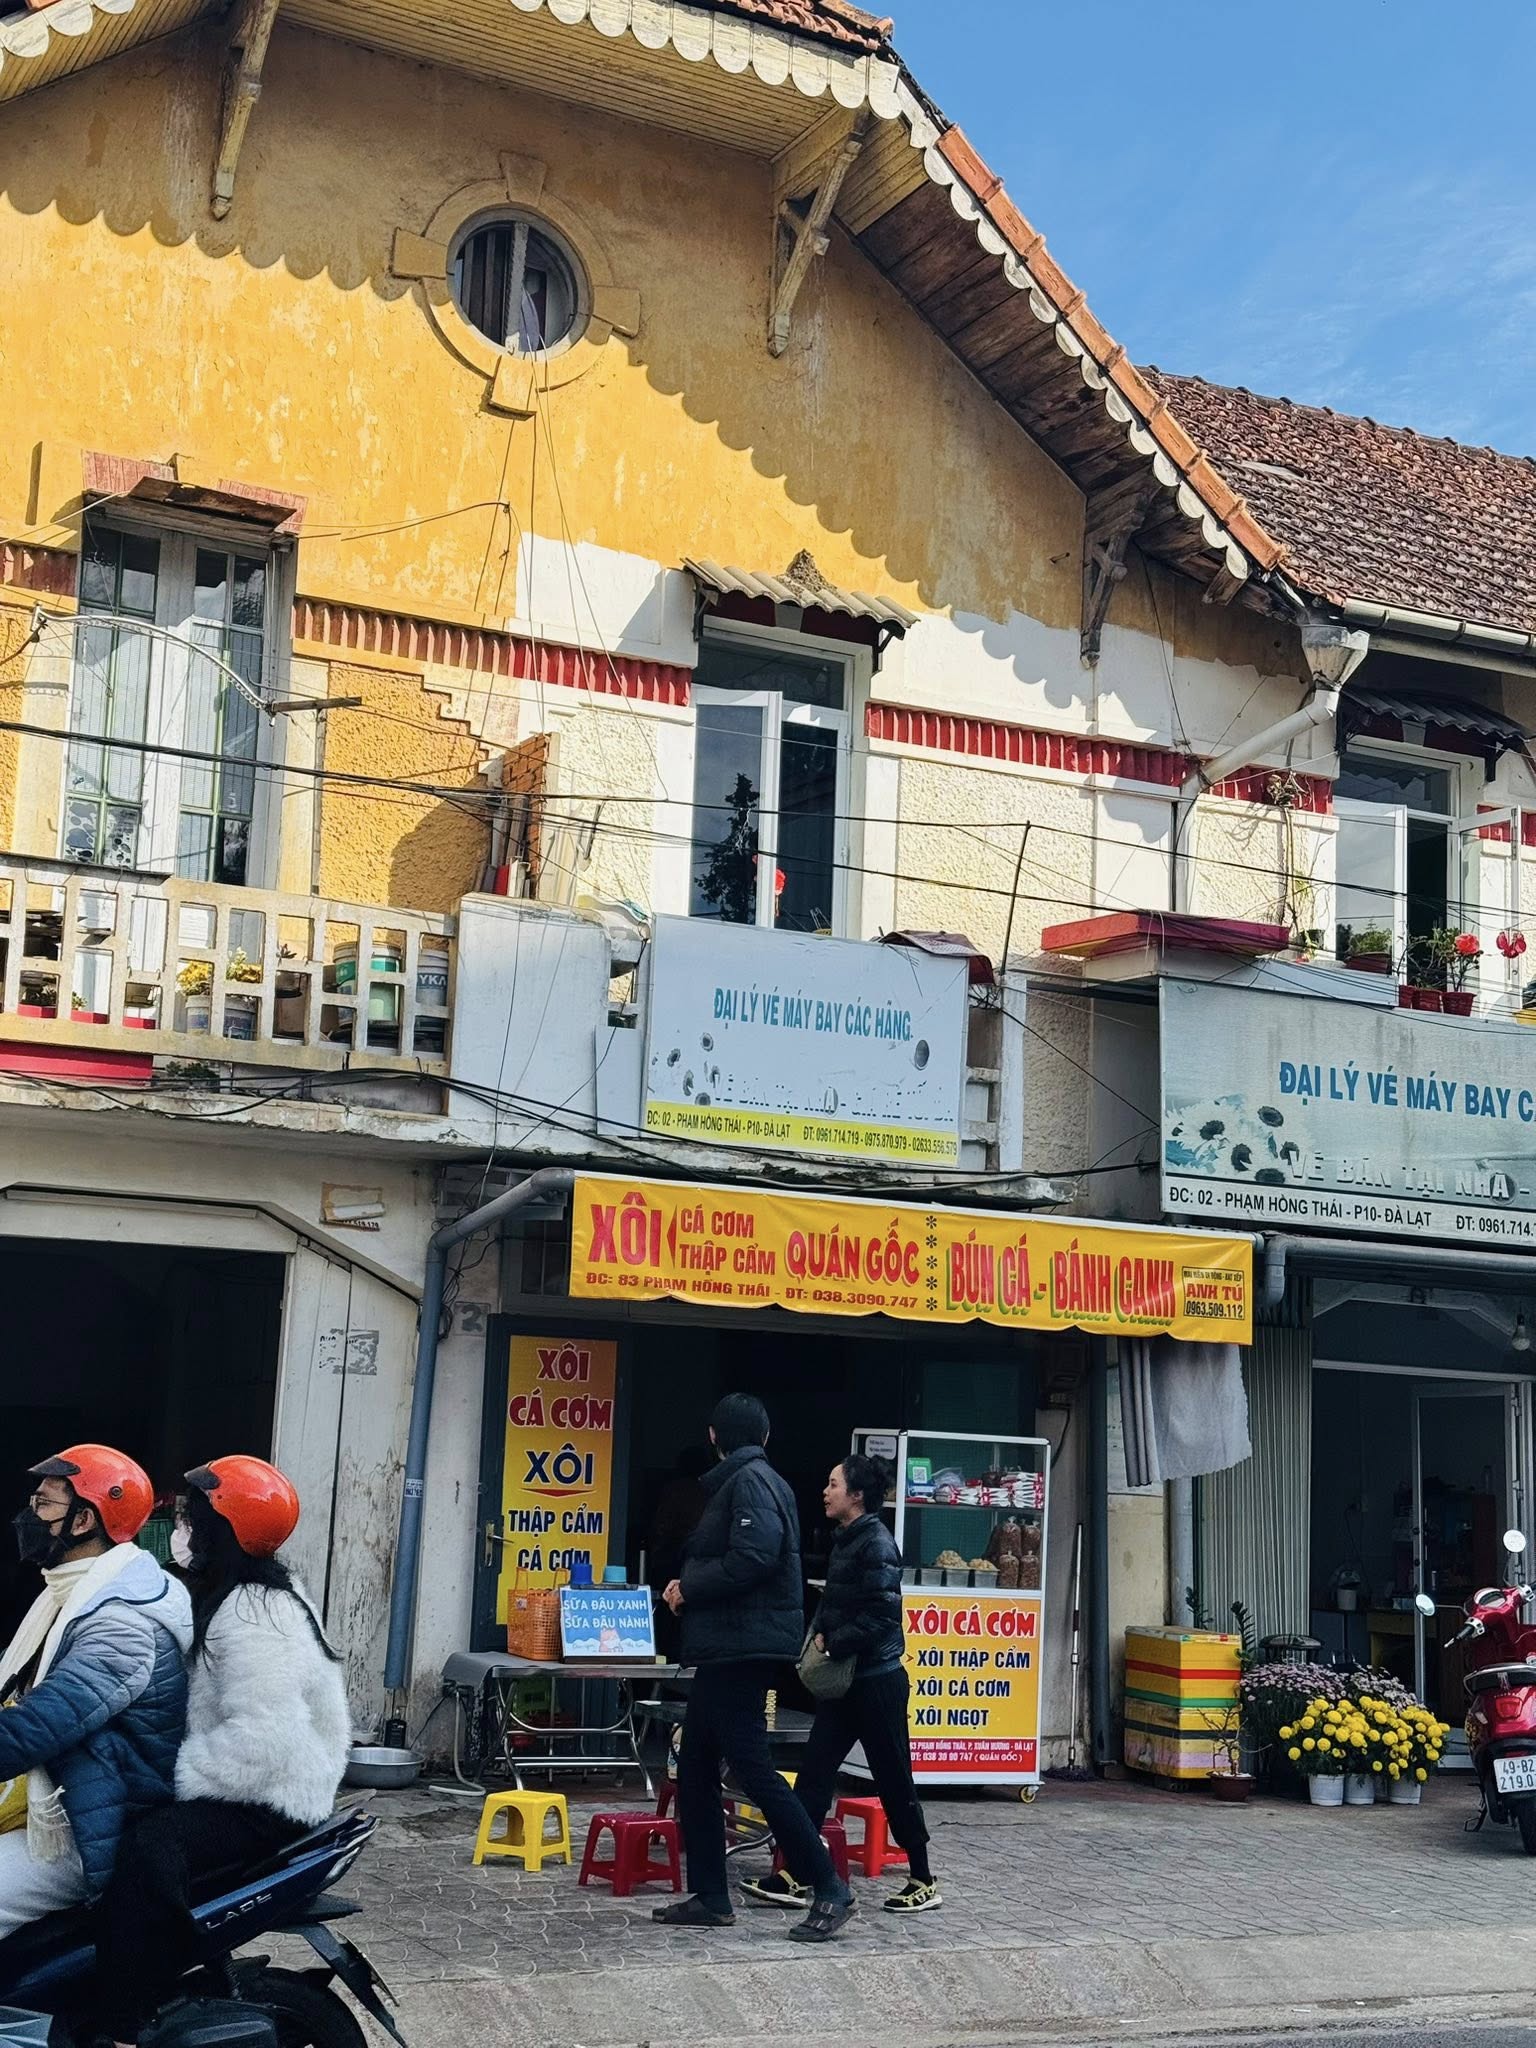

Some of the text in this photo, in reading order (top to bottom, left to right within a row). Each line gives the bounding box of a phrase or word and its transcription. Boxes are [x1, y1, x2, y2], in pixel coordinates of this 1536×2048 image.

[713, 987, 738, 1030] ĐẠI
[740, 983, 759, 1023] LÝ
[762, 986, 780, 1026] VÉ
[783, 989, 813, 1030] MÁY
[815, 1000, 843, 1033] BAY
[844, 996, 872, 1037] CÁC
[1279, 1060, 1536, 1122] ĐẠI LÝ VÉ MÁY BAY C
[647, 1110, 660, 1126] ĐC:
[662, 1111, 671, 1127] 02
[676, 1112, 699, 1132] PHẠM
[724, 1115, 742, 1134] THÁI
[776, 1124, 791, 1141] LẠT
[803, 1126, 815, 1141] ĐT:
[816, 1127, 859, 1145] 0961.714.719
[680, 1203, 754, 1239] CÁ CƠM
[1169, 1186, 1194, 1204] ĐC:
[1197, 1189, 1213, 1206] 02
[1225, 1192, 1264, 1213] PHẠM
[1311, 1198, 1342, 1218] THÁI
[1384, 1205, 1403, 1224] ĐÀ
[1407, 1210, 1432, 1229] LẠT
[1456, 1215, 1475, 1231] ĐT:
[588, 1191, 663, 1268] XÔI
[679, 1241, 776, 1276] THẬP CẨM
[785, 1216, 921, 1286] QUÁN GỐC
[586, 1272, 613, 1286] ĐC:
[617, 1274, 639, 1288] 83
[737, 1282, 770, 1298] THÁI
[785, 1287, 809, 1300] ĐT:
[812, 1289, 919, 1309] 038.3090.747
[949, 1228, 995, 1309] BÚN
[1001, 1232, 1031, 1311] CÁ
[1052, 1237, 1112, 1318] BÁNH
[1117, 1255, 1176, 1321] CANH
[1186, 1283, 1243, 1302] ANH TÚ
[1186, 1300, 1243, 1318] 0963.509.112
[537, 1341, 590, 1382] XÔI
[509, 1386, 613, 1430] CÁ CƠM
[523, 1442, 594, 1485] XÔI
[508, 1502, 603, 1538] THẬP CẨM
[517, 1543, 591, 1572] CÁ CƠM
[563, 1596, 647, 1613] SỮA ĐẬU XANH
[565, 1615, 589, 1628] SỮA
[619, 1614, 649, 1628] NÀNH
[906, 1603, 1035, 1637] XÔI CÁ CƠM
[917, 1645, 1030, 1671] XÔI THẬP CẨM
[916, 1675, 1010, 1697] XÔI CÁ CƠM
[915, 1705, 989, 1730] XÔI NGỌT
[960, 1752, 972, 1762] 747
[1500, 1774, 1536, 1791] 219.0
